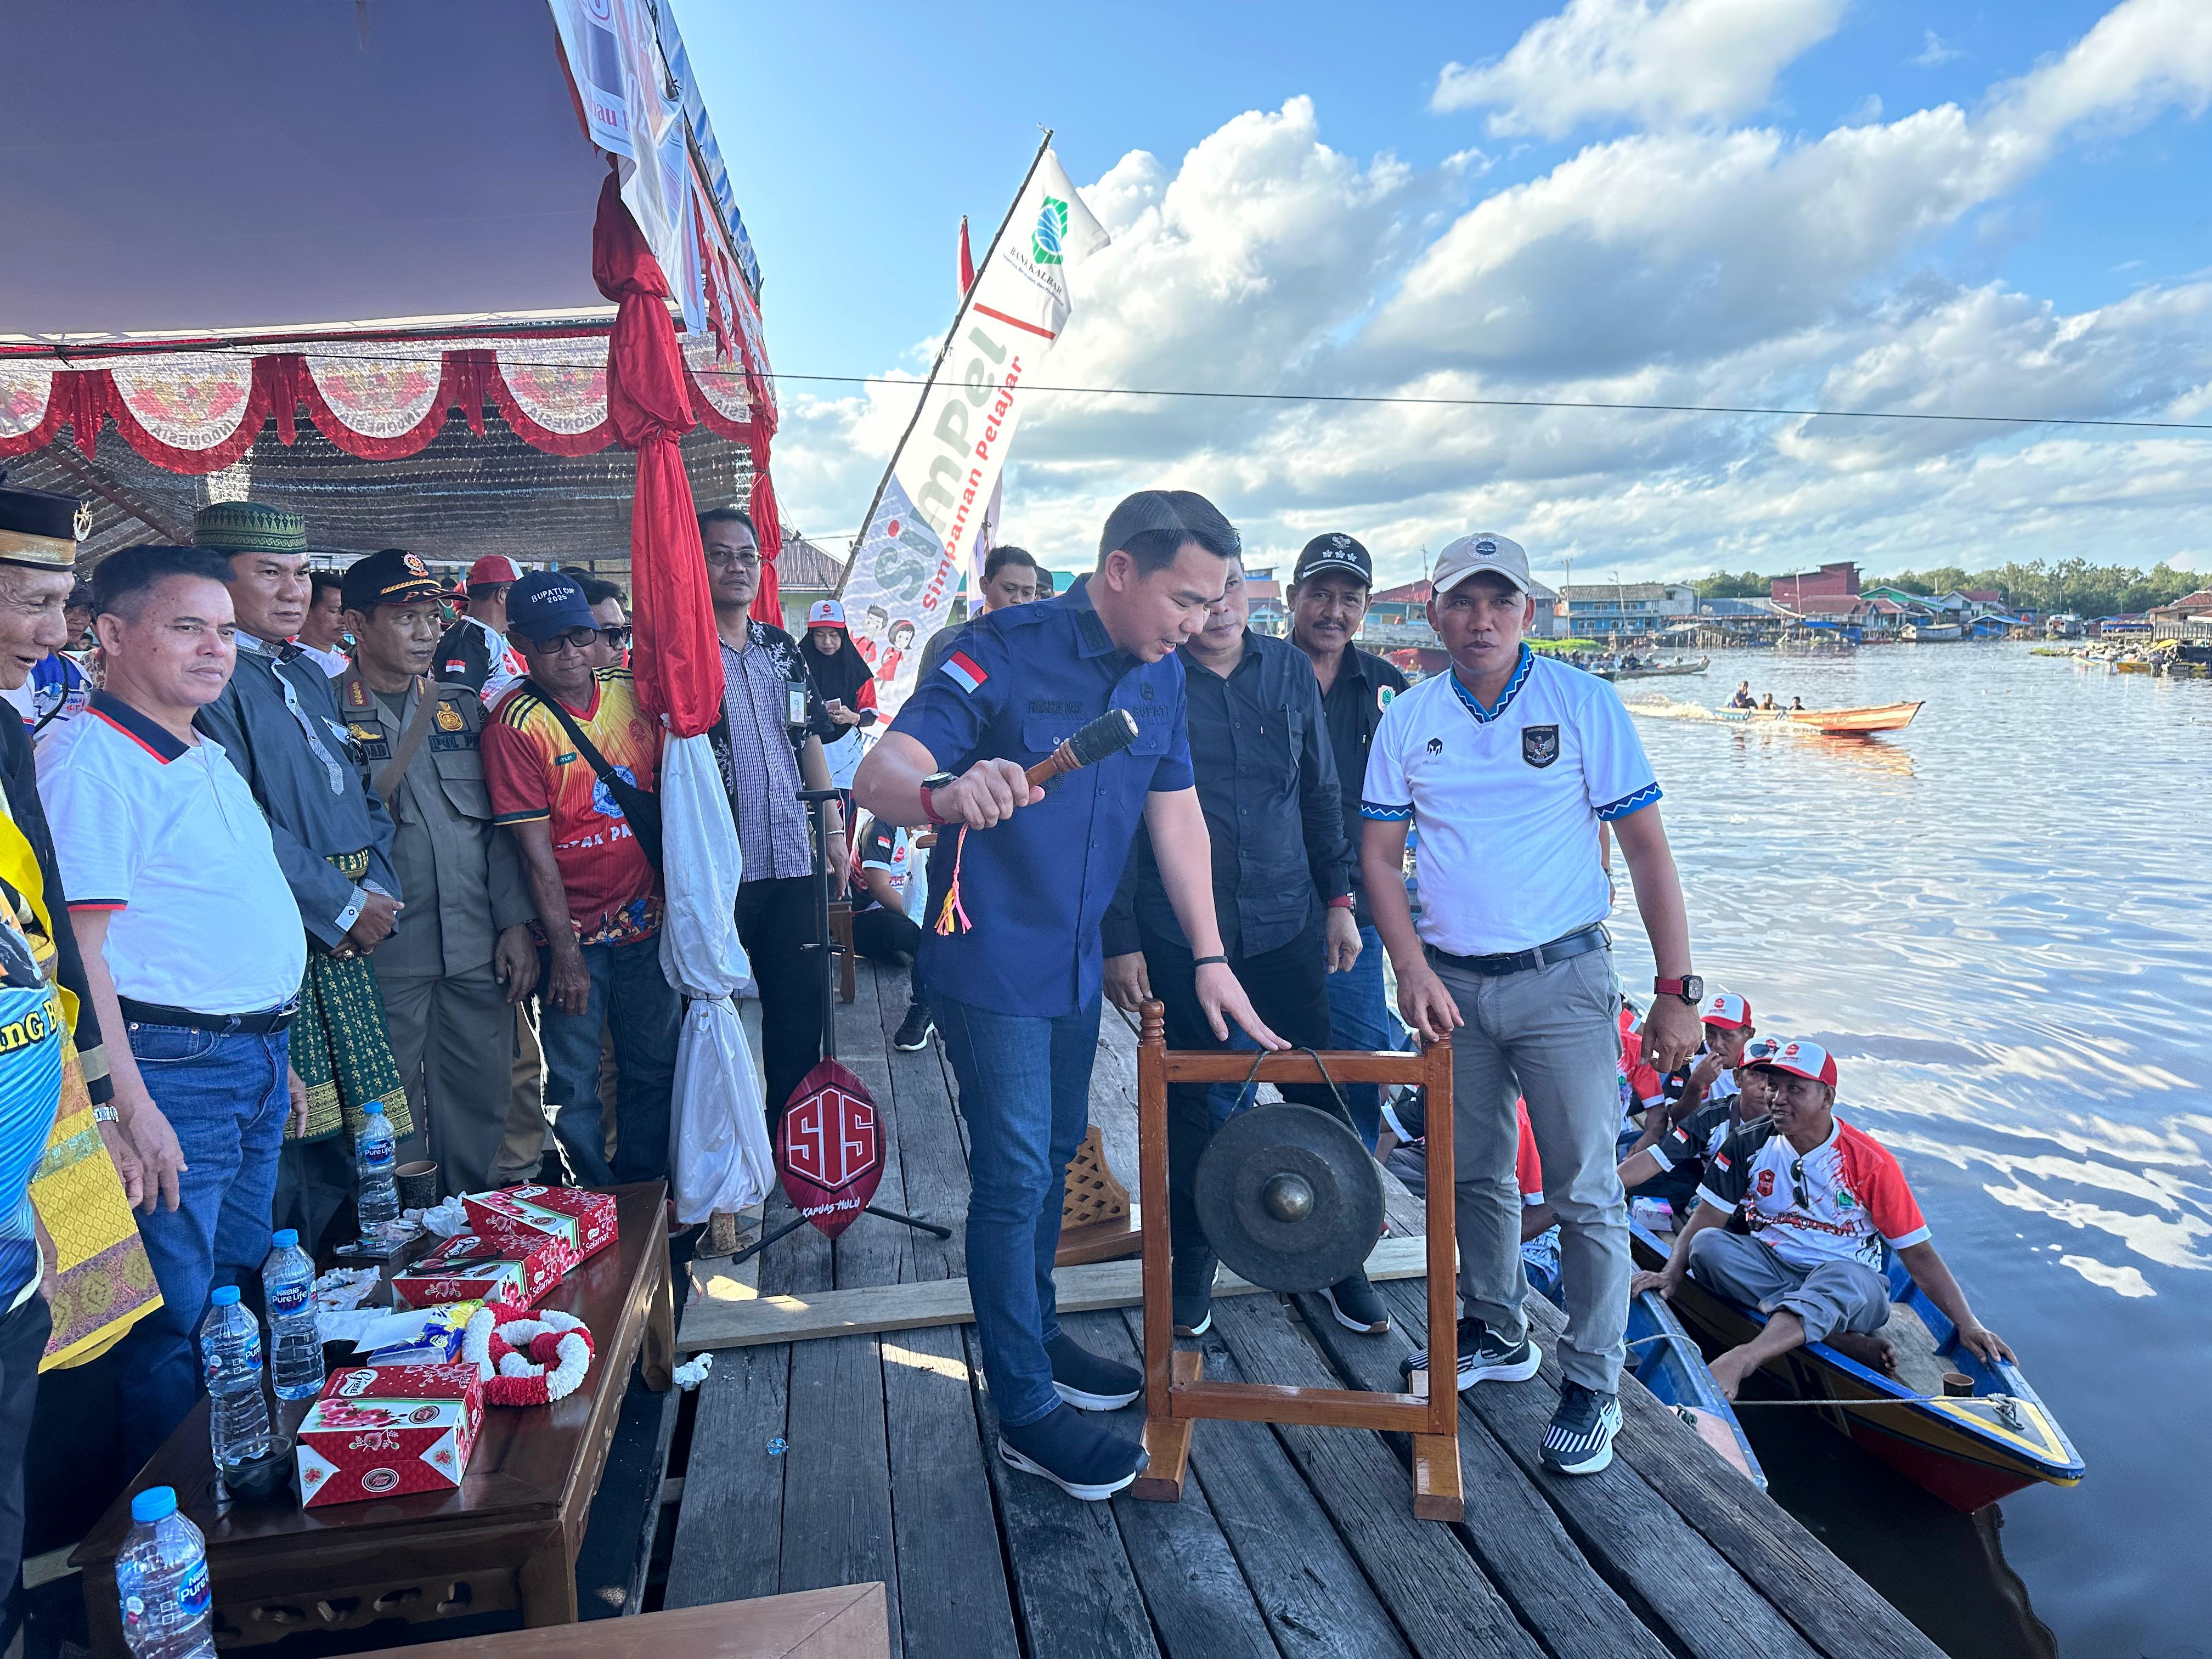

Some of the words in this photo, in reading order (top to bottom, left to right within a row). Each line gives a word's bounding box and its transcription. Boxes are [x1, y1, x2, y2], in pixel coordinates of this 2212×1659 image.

[1011, 246, 1028, 268] BANK
[1029, 263, 1062, 296] KALBAR
[874, 326, 1007, 602] SimPel
[923, 467, 983, 612] Simpanan
[975, 356, 1023, 461] Pelajar
[531, 587, 562, 603] BUPATI
[547, 594, 567, 603] 2025
[1133, 706, 1170, 718] BUPATI
[430, 736, 460, 749] POL
[610, 823, 633, 842] PA
[788, 1088, 876, 1187] SIS
[381, 1146, 392, 1155] Life
[802, 1203, 834, 1218] KAPUAS
[585, 1231, 610, 1252] Selamat
[532, 1274, 554, 1297] Selamat
[272, 1293, 292, 1303] Pure
[293, 1290, 307, 1302] Life
[180, 1578, 206, 1602] Pure
